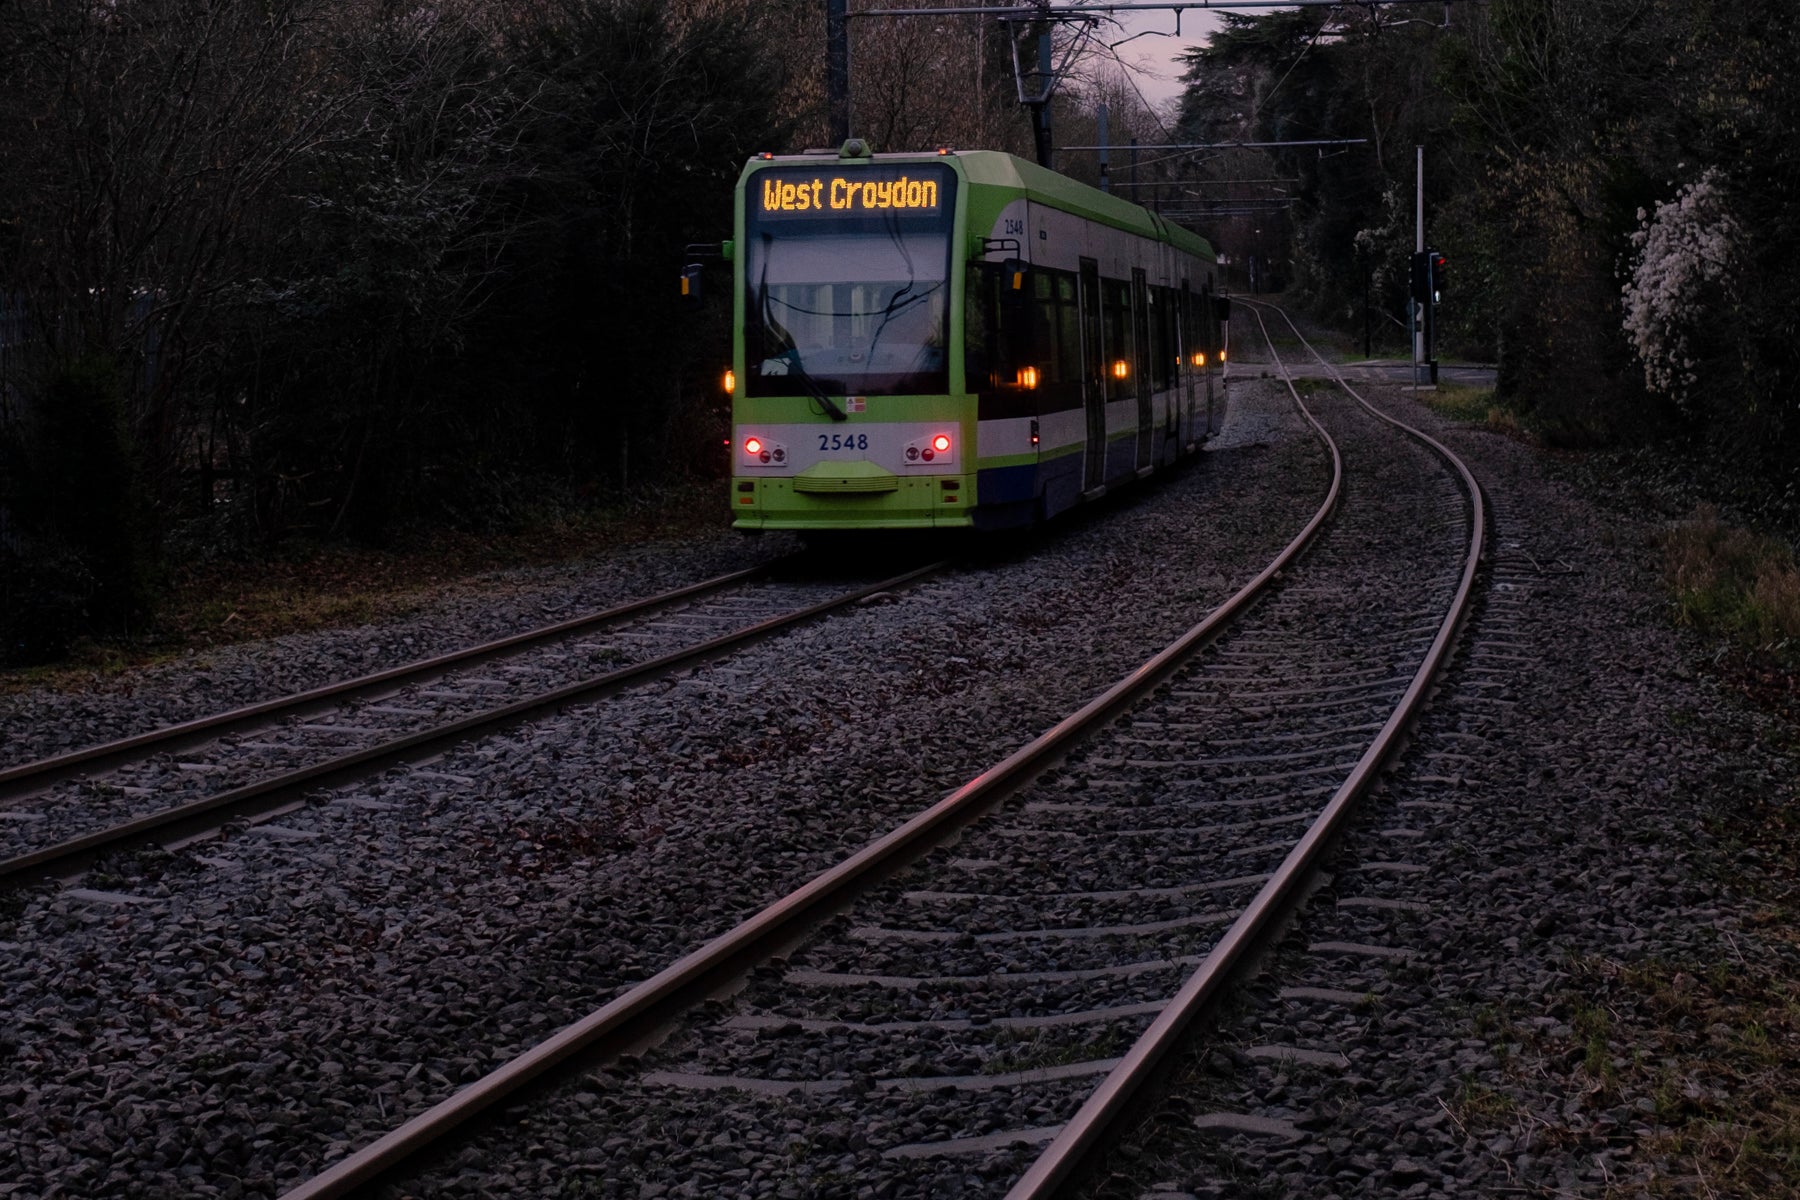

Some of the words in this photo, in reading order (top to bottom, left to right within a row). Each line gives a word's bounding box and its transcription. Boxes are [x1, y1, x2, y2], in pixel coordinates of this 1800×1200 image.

[763, 179, 823, 211] West
[830, 176, 937, 209] Croydon
[1005, 218, 1024, 235] 2548
[818, 434, 869, 451] 2548
